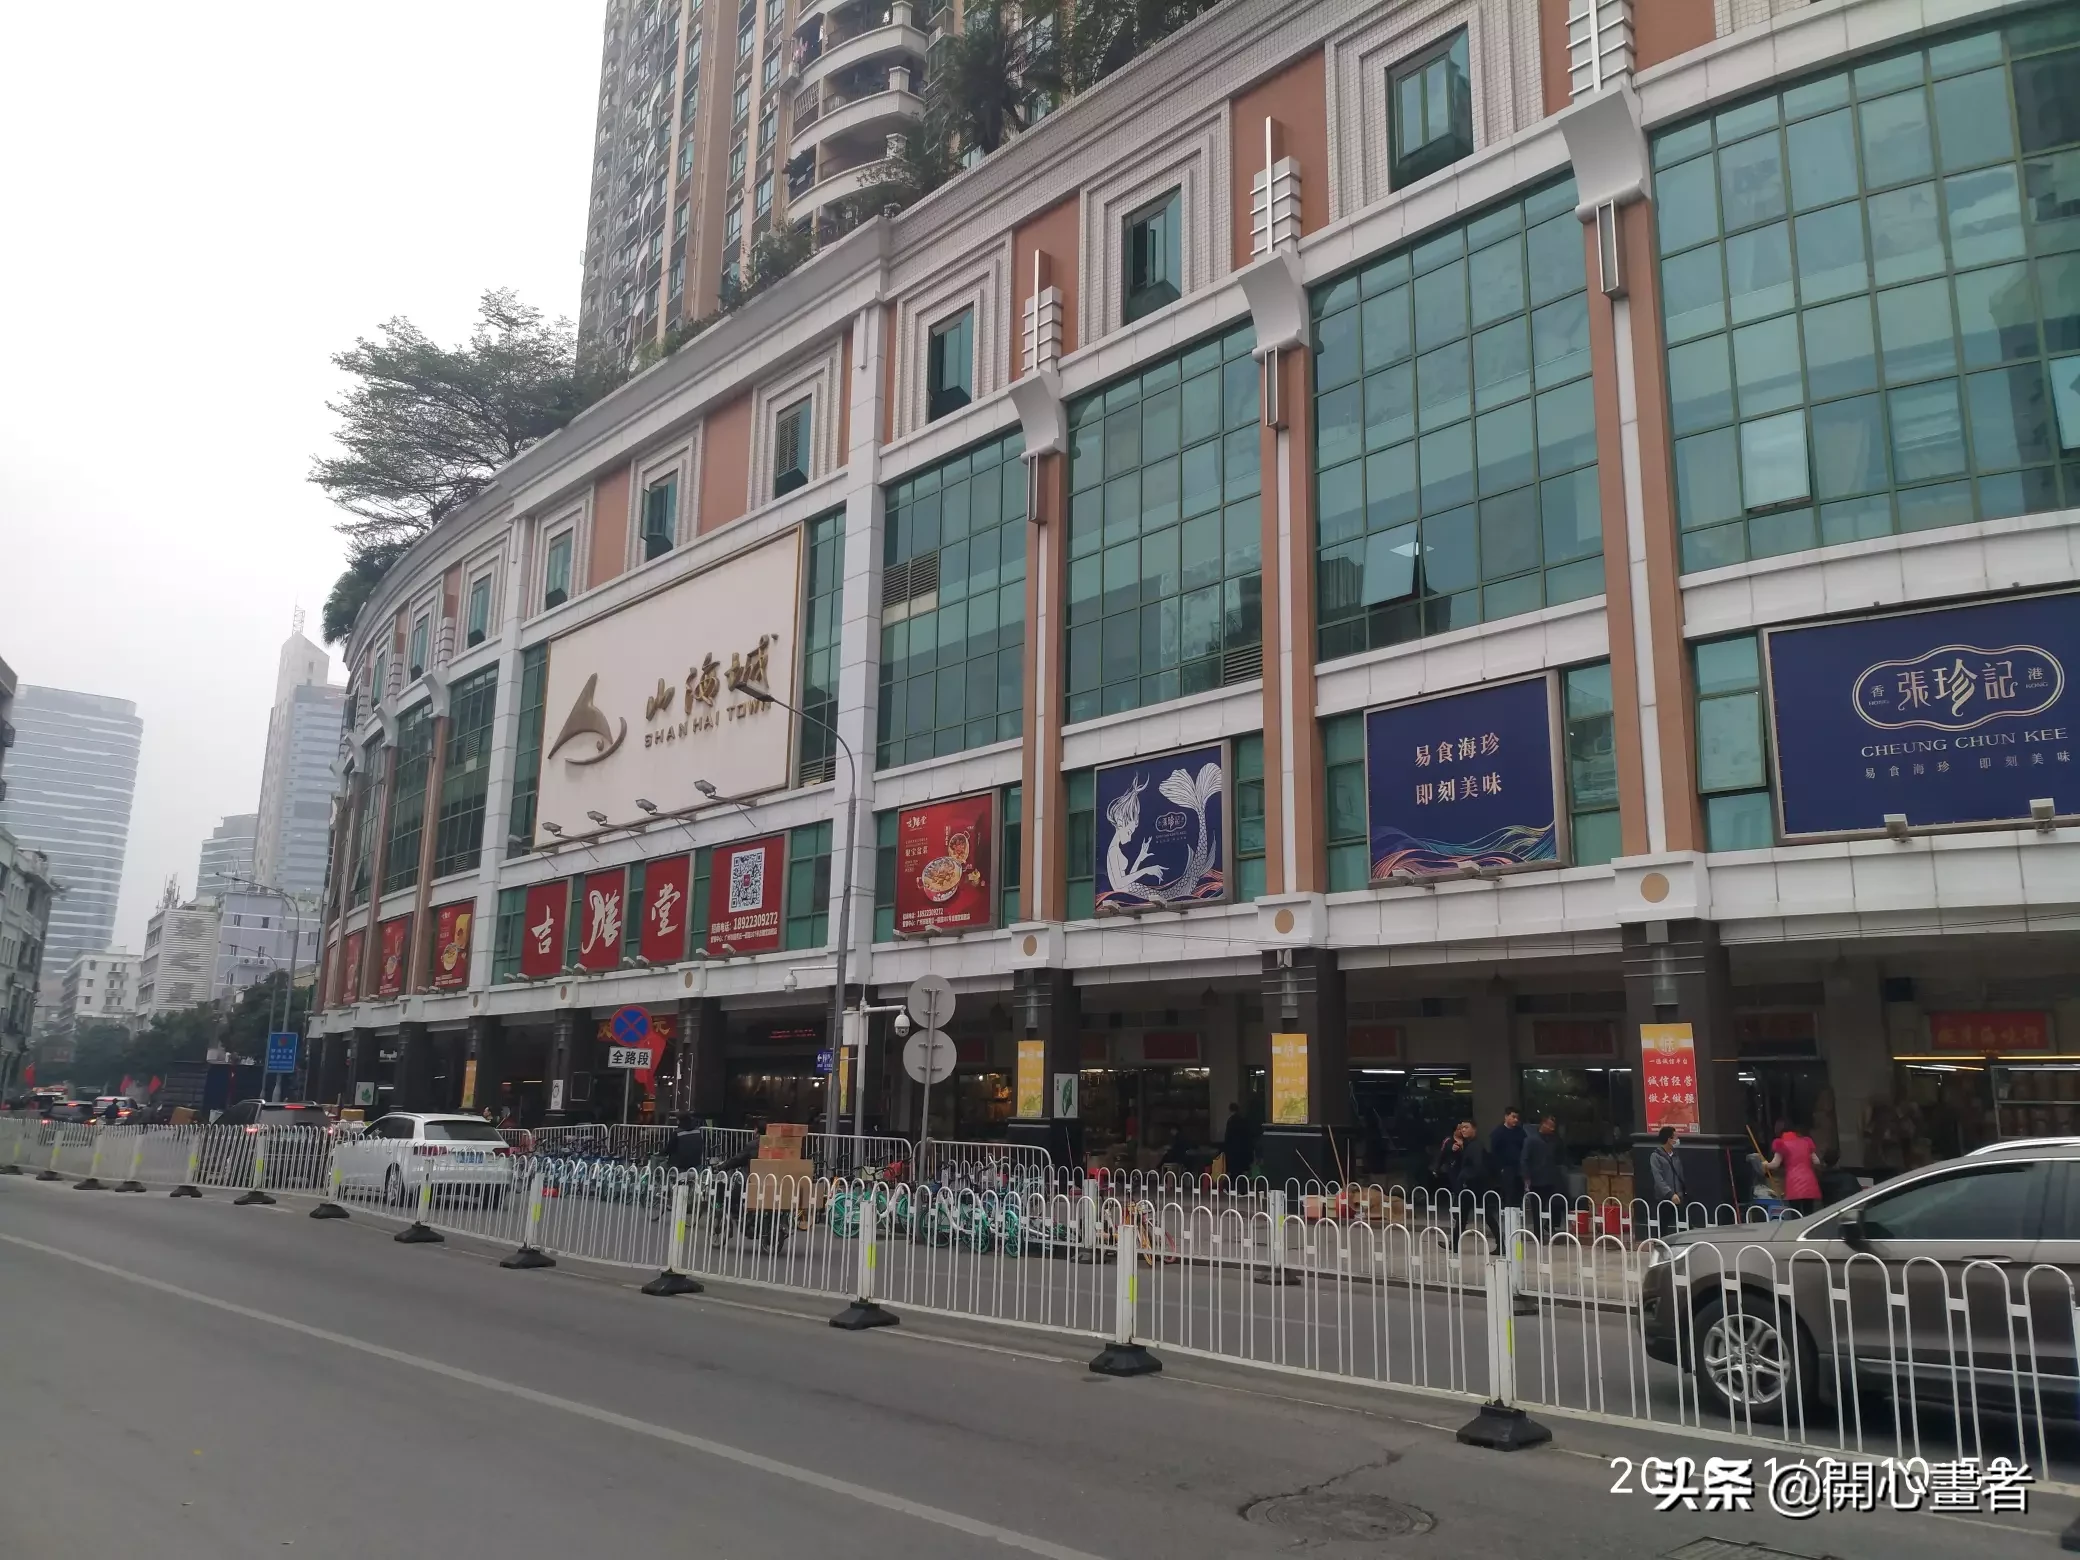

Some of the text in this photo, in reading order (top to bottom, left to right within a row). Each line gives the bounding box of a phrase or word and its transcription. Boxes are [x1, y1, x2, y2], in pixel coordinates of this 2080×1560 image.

[645, 633, 779, 721] 山海城
[1870, 666, 2044, 698] 香 港
[1896, 658, 2019, 718] 張珍記
[644, 721, 689, 748] SHAN
[692, 710, 720, 734] HAI
[1861, 727, 2069, 758] CHEUNG CHUN KEE
[1414, 730, 1502, 768] 易食海珍
[1864, 750, 2071, 779] 易食海珍 即刻美味
[1414, 771, 1503, 807] 即刻美味
[733, 911, 778, 930] 18922309272
[611, 1050, 650, 1066] 全路段
[1647, 1075, 1694, 1088] 诚信经营
[1648, 1092, 1696, 1105] 做大做强
